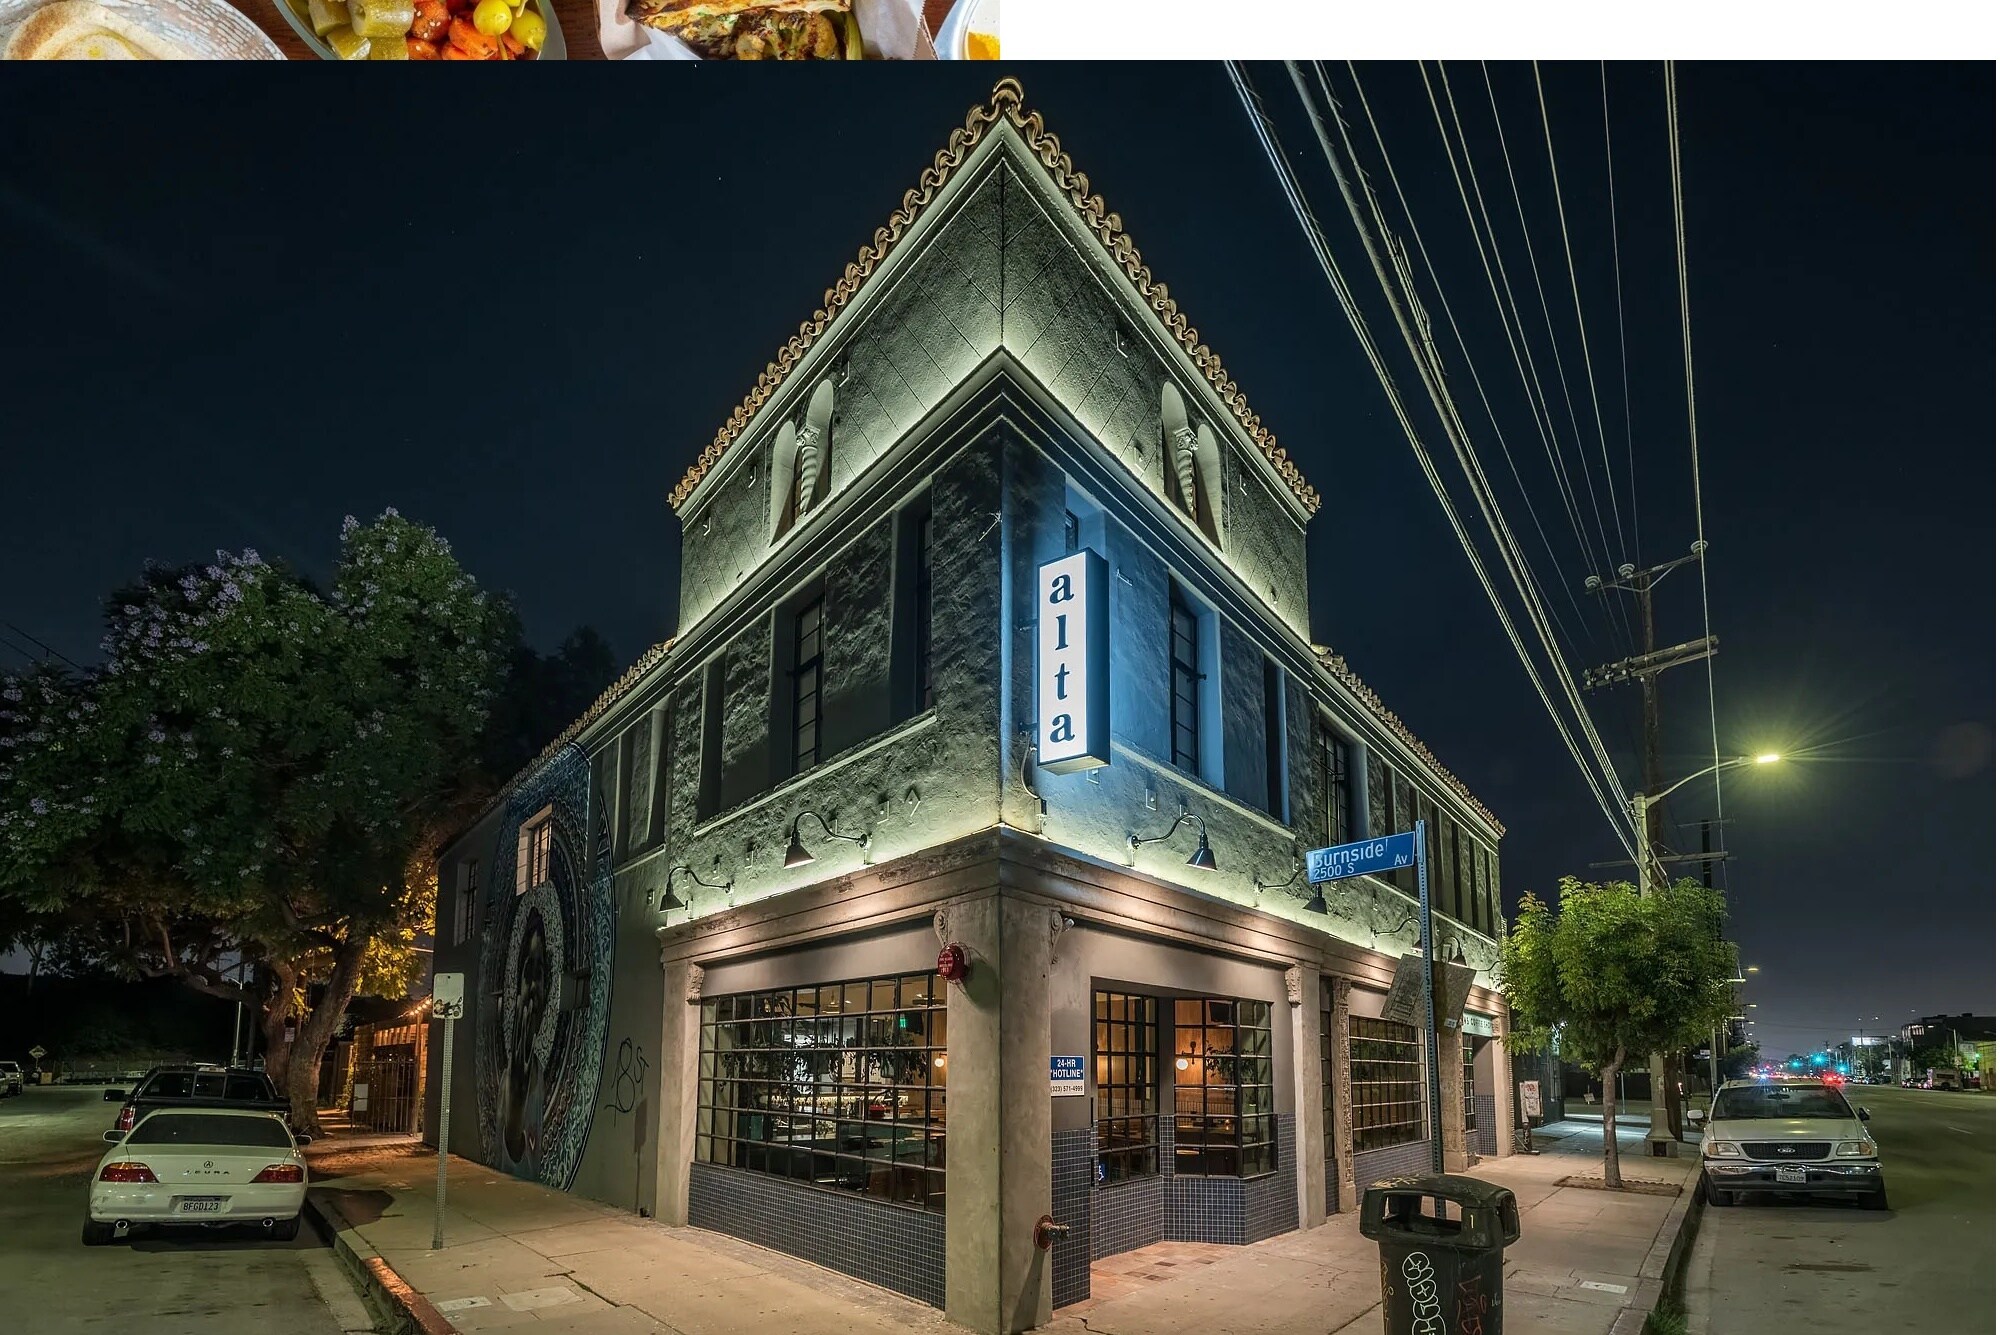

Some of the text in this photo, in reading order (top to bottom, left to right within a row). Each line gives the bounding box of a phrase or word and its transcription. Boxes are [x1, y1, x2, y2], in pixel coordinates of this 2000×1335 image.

[1049, 574, 1075, 744] alta
[1313, 854, 1408, 880] 2500 S Av
[1314, 842, 1384, 868] Burnside
[1057, 1059, 1076, 1068] 24-HR
